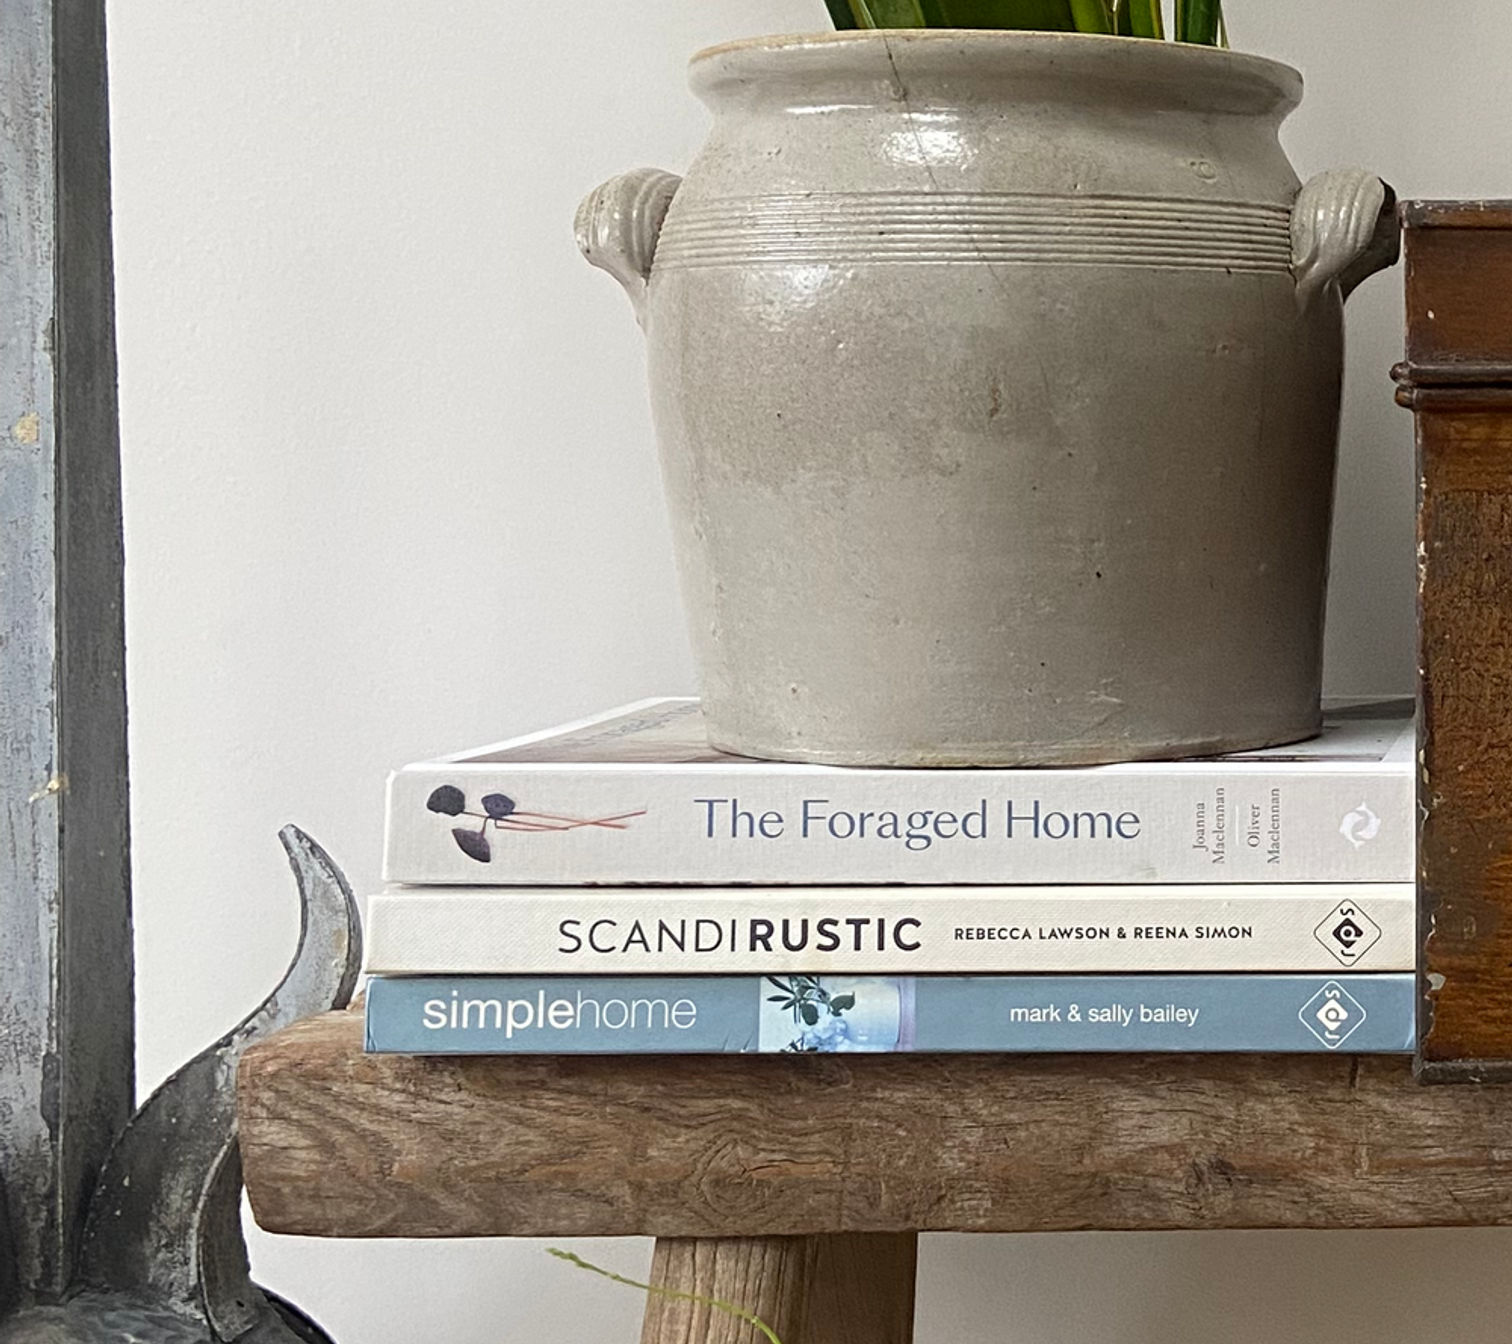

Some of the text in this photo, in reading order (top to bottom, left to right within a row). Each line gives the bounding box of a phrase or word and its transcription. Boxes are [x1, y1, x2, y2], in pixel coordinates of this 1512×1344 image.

[693, 798, 1142, 850] The Foraged Home
[1192, 802, 1209, 852] Joanna
[1212, 787, 1225, 864] Maclennan
[1247, 803, 1261, 848] Oliver
[1266, 787, 1280, 864] Maclennan
[558, 918, 923, 954] SCANDIRUSTIC
[954, 925, 1253, 941] REBECCA LAWSON & REENA SIMON
[422, 989, 698, 1039] simplehome
[1010, 1004, 1200, 1027] mark & sally bailey
